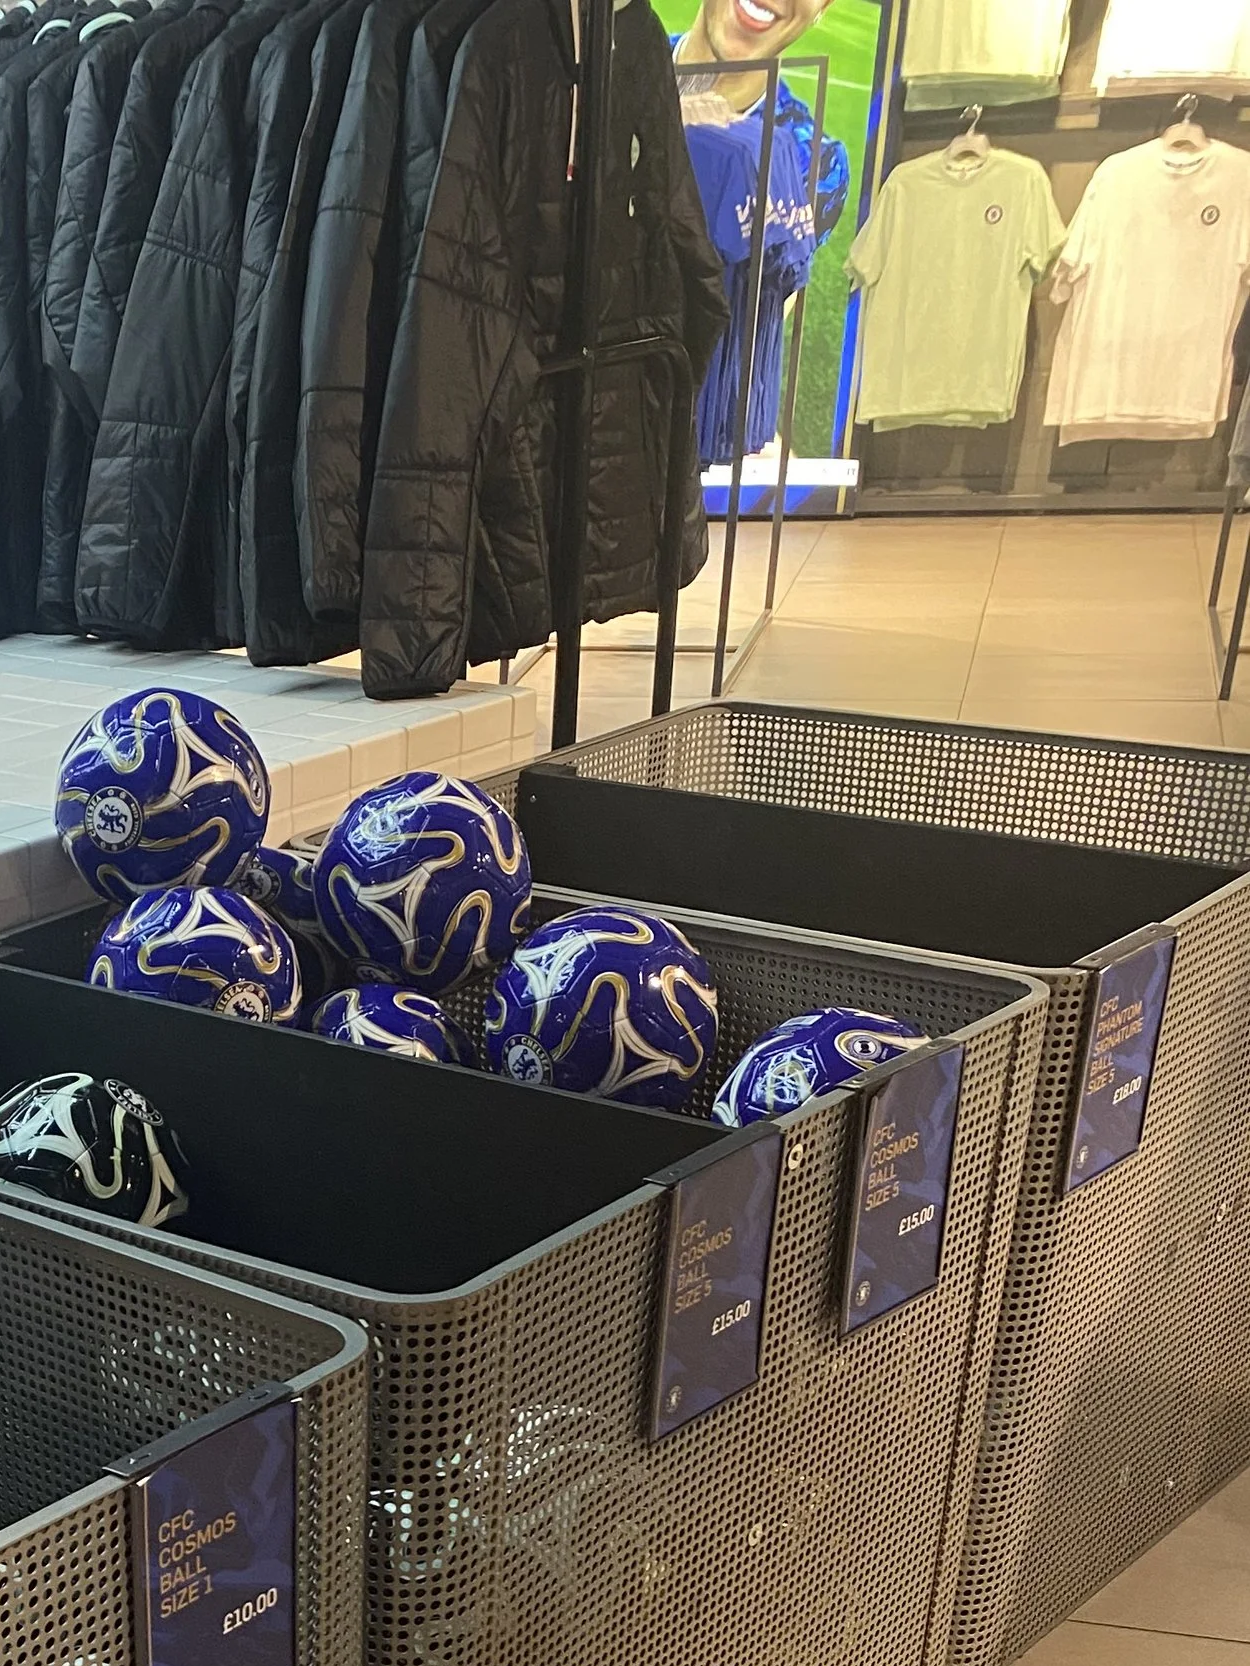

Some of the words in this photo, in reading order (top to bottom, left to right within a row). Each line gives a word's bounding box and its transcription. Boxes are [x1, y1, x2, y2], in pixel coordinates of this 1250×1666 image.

[1096, 1000, 1144, 1039] PHANTOM
[1100, 995, 1119, 1018] CFC
[1093, 1017, 1144, 1057] SIGNATURE
[1090, 1052, 1114, 1078] BALL
[1087, 1073, 1108, 1096] SIZE
[870, 1132, 919, 1168] COSMOS
[873, 1122, 896, 1147] CFC
[868, 1163, 897, 1191] BALL
[865, 1185, 891, 1211] SIZE
[892, 1181, 900, 1198] 5
[681, 1220, 707, 1247] CFC
[898, 1204, 935, 1237] £15.00
[678, 1227, 733, 1269] COSMOS
[676, 1262, 709, 1293] BALL
[674, 1285, 703, 1315] SIZE
[703, 1279, 712, 1297] 5
[711, 1299, 751, 1336] £15.00
[158, 1508, 196, 1544] CFC
[158, 1512, 237, 1569] COSMOS
[160, 1555, 207, 1595] BALL
[160, 1581, 200, 1620] SIZE
[204, 1575, 214, 1596] 1
[222, 1587, 278, 1635] £10.00
